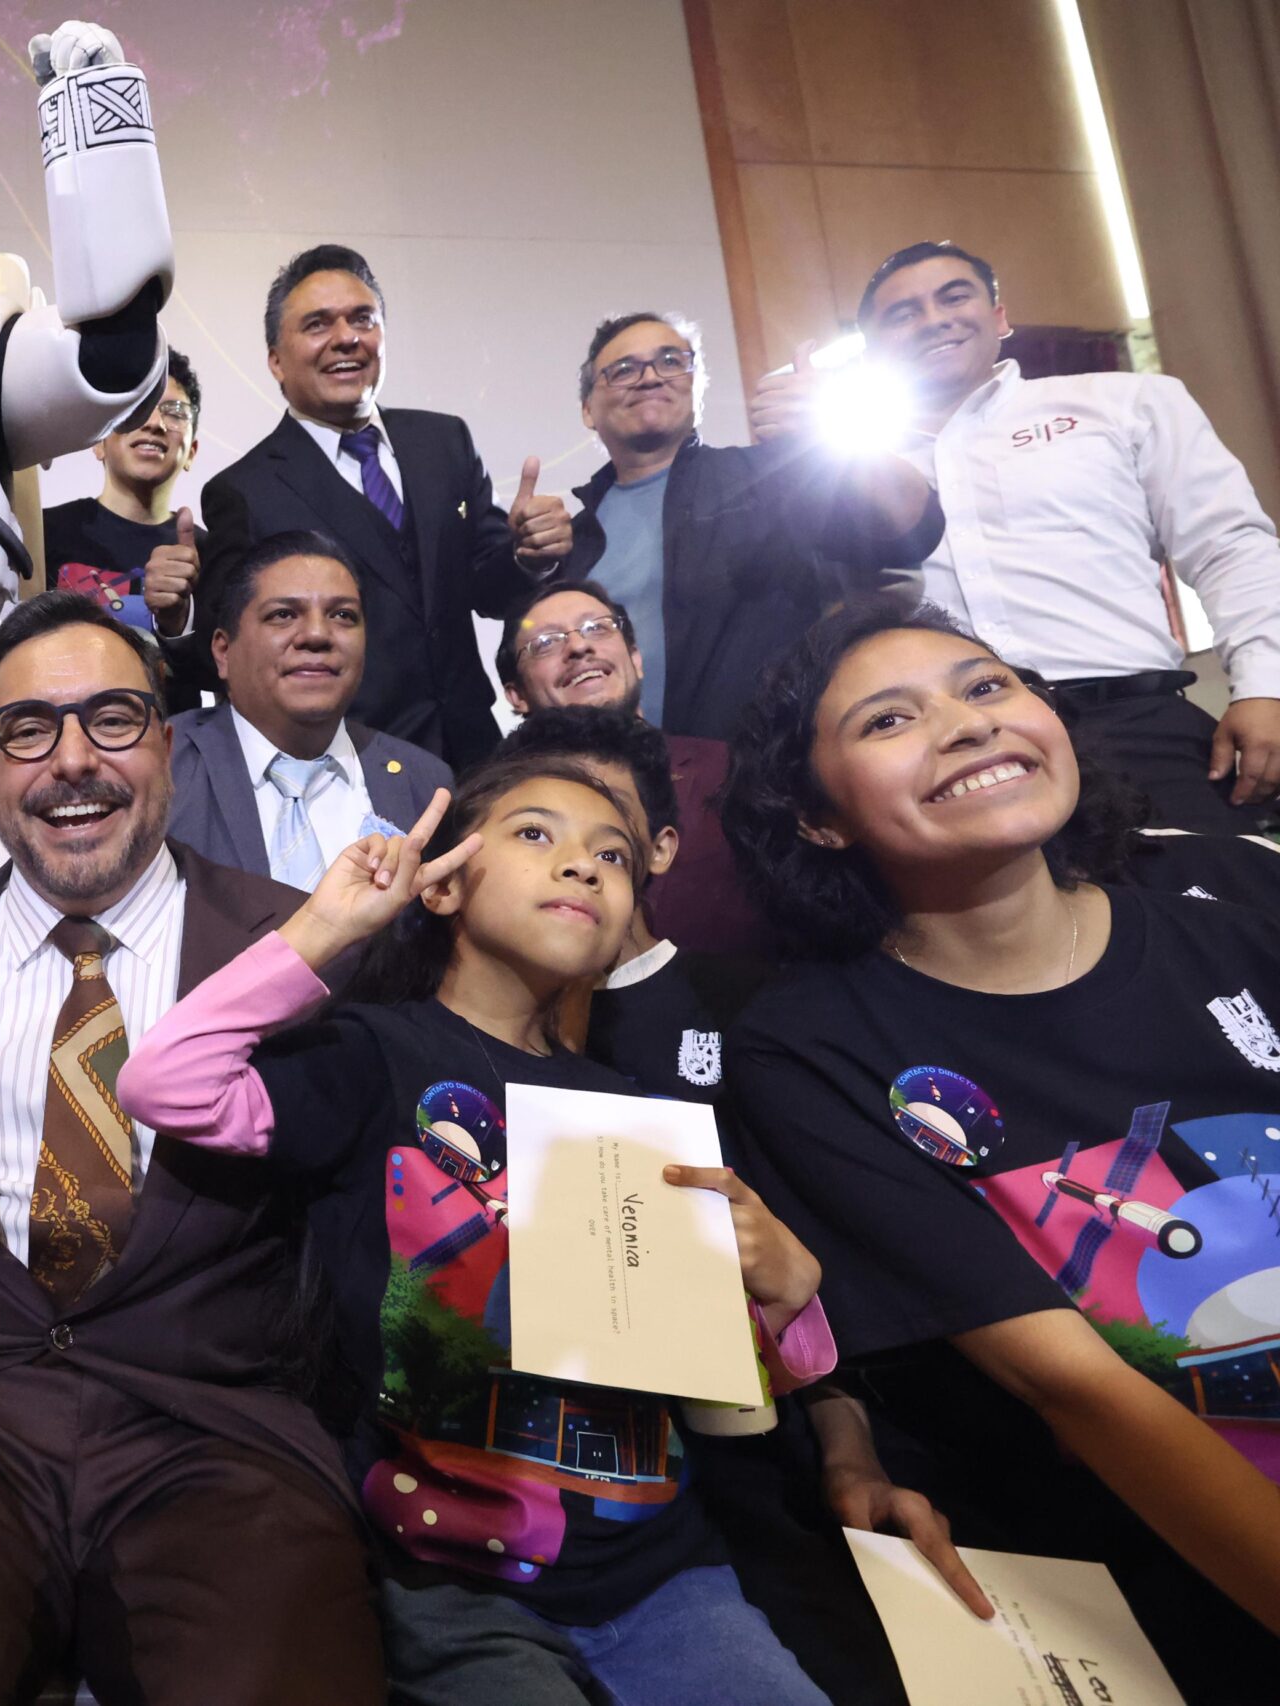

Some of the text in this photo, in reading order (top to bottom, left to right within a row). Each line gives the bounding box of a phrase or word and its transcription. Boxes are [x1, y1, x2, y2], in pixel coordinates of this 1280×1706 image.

[897, 1066, 977, 1090] CONTACTO DIRECTO
[422, 1081, 455, 1105] CONTACTO
[601, 1187, 609, 1202] take
[604, 1225, 612, 1234] of
[622, 1192, 650, 1269] Veronica
[605, 1237, 614, 1261] mental
[607, 1265, 616, 1291] health
